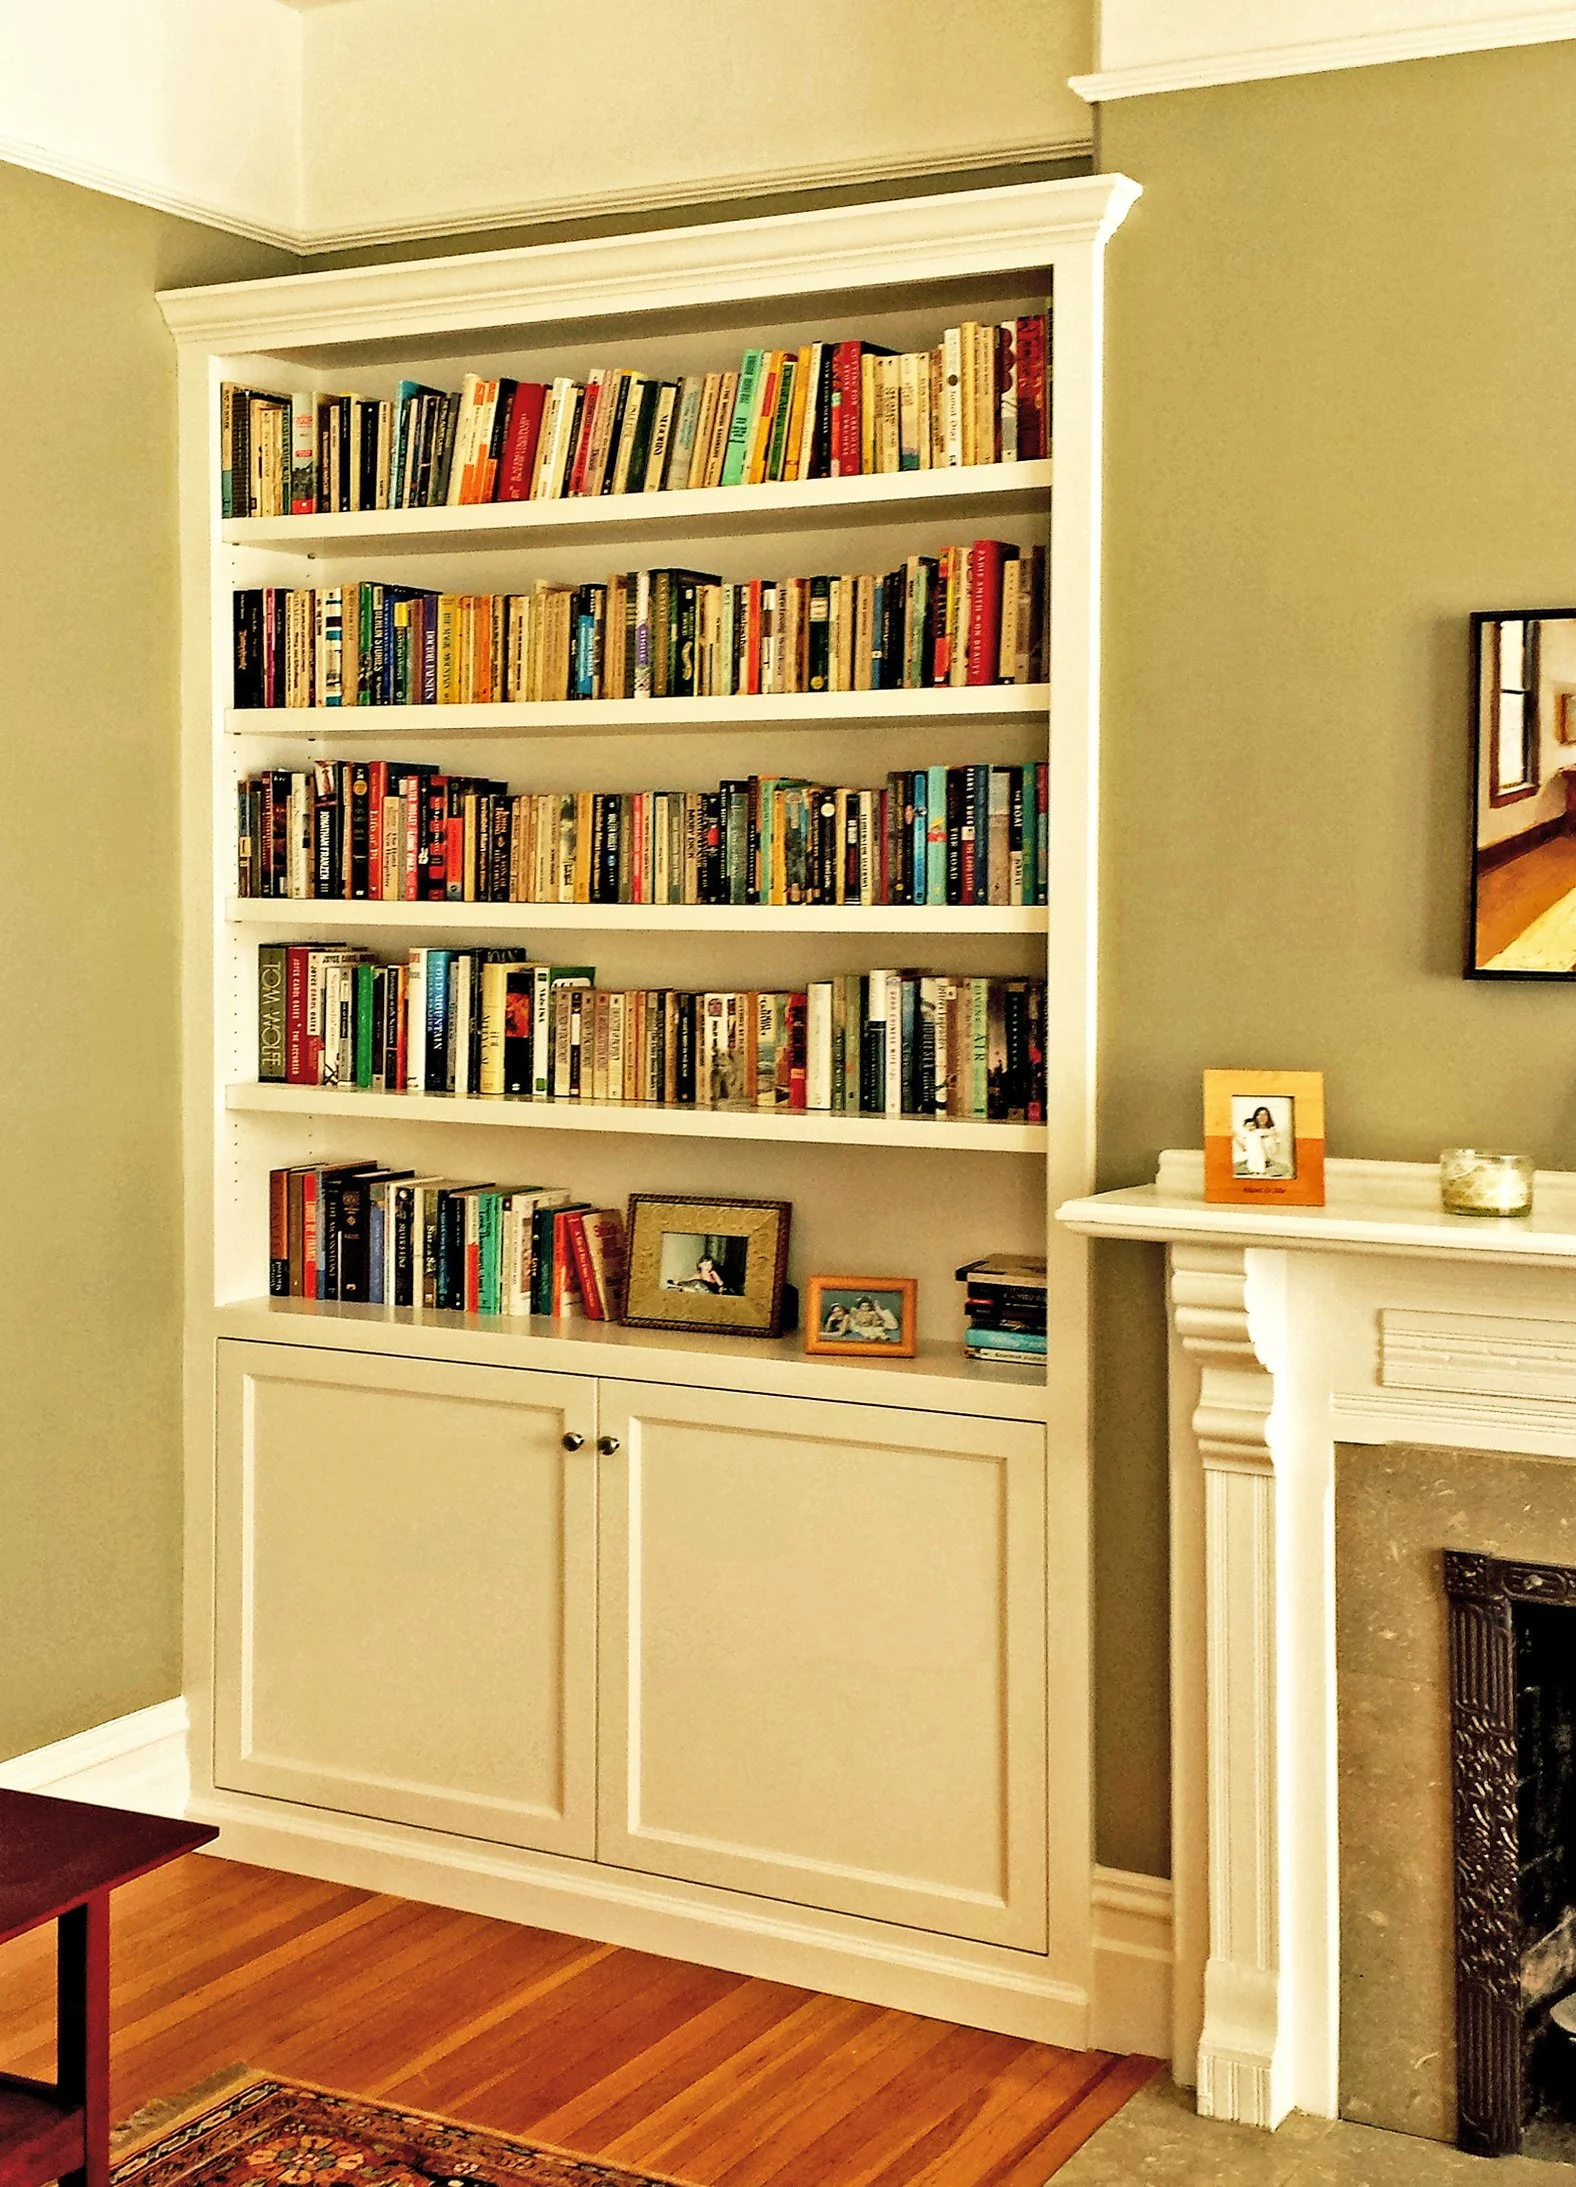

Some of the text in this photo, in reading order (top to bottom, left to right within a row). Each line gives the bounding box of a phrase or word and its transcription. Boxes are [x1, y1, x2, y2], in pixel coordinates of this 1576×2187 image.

[850, 348, 860, 406] CUTTING FOR
[842, 414, 850, 456] VERGHESE
[850, 416, 858, 455] ABRAHAM
[975, 550, 986, 612] ZADIE SMITH
[374, 611, 384, 672] BERLIN STORIES
[442, 613, 451, 689] THE MAGIC MOUNTAIN
[972, 623, 982, 675] ON BEAUTY
[425, 631, 434, 701] DOCTOR FAUSTUS
[966, 767, 975, 792] PEARL
[370, 810, 378, 832] Life
[479, 797, 488, 852] Invisible Man
[494, 807, 503, 835] IRVING
[500, 811, 509, 833] JOHN
[687, 809, 695, 859] MOBY DICK
[967, 806, 975, 825] BUCK
[1014, 805, 1022, 827] BOAT
[320, 811, 330, 880] JONATHAN FRANZEN
[370, 849, 378, 860] Pi
[950, 827, 958, 880] THE ROAD
[292, 958, 300, 1019] JOYCE CAROL OATES
[433, 960, 444, 1050] COLD MOUNTAIN
[262, 962, 281, 1067] TOM WOLFE
[291, 1031, 300, 1075] THE ACCURSED
[974, 1033, 984, 1061] AIR
[426, 1225, 435, 1242] Star
[426, 1257, 436, 1273] Sea
[531, 1257, 539, 1277] Love
